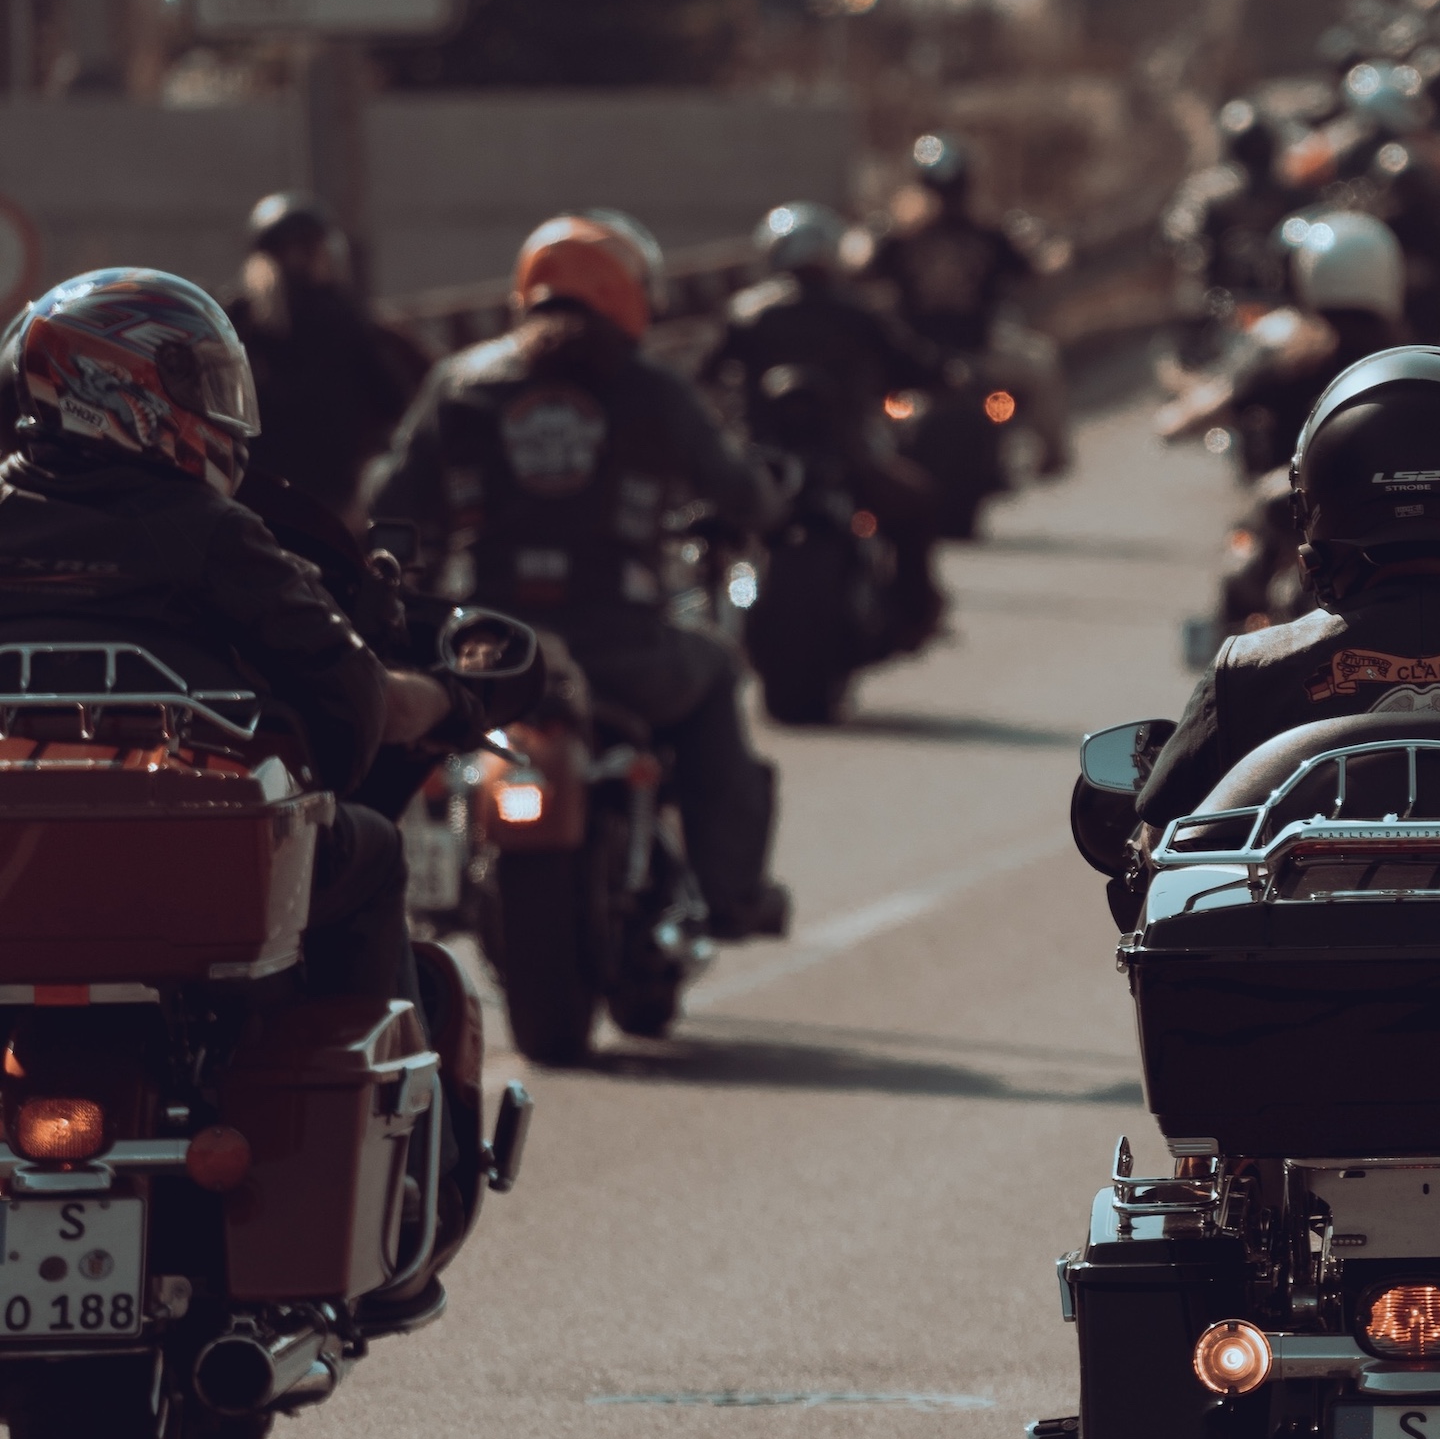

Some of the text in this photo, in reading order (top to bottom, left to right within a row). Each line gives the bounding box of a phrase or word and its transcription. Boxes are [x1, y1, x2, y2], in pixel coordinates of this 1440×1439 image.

[1385, 484, 1431, 492] STROBE
[59, 1203, 85, 1240] S
[49, 1293, 134, 1330] 188
